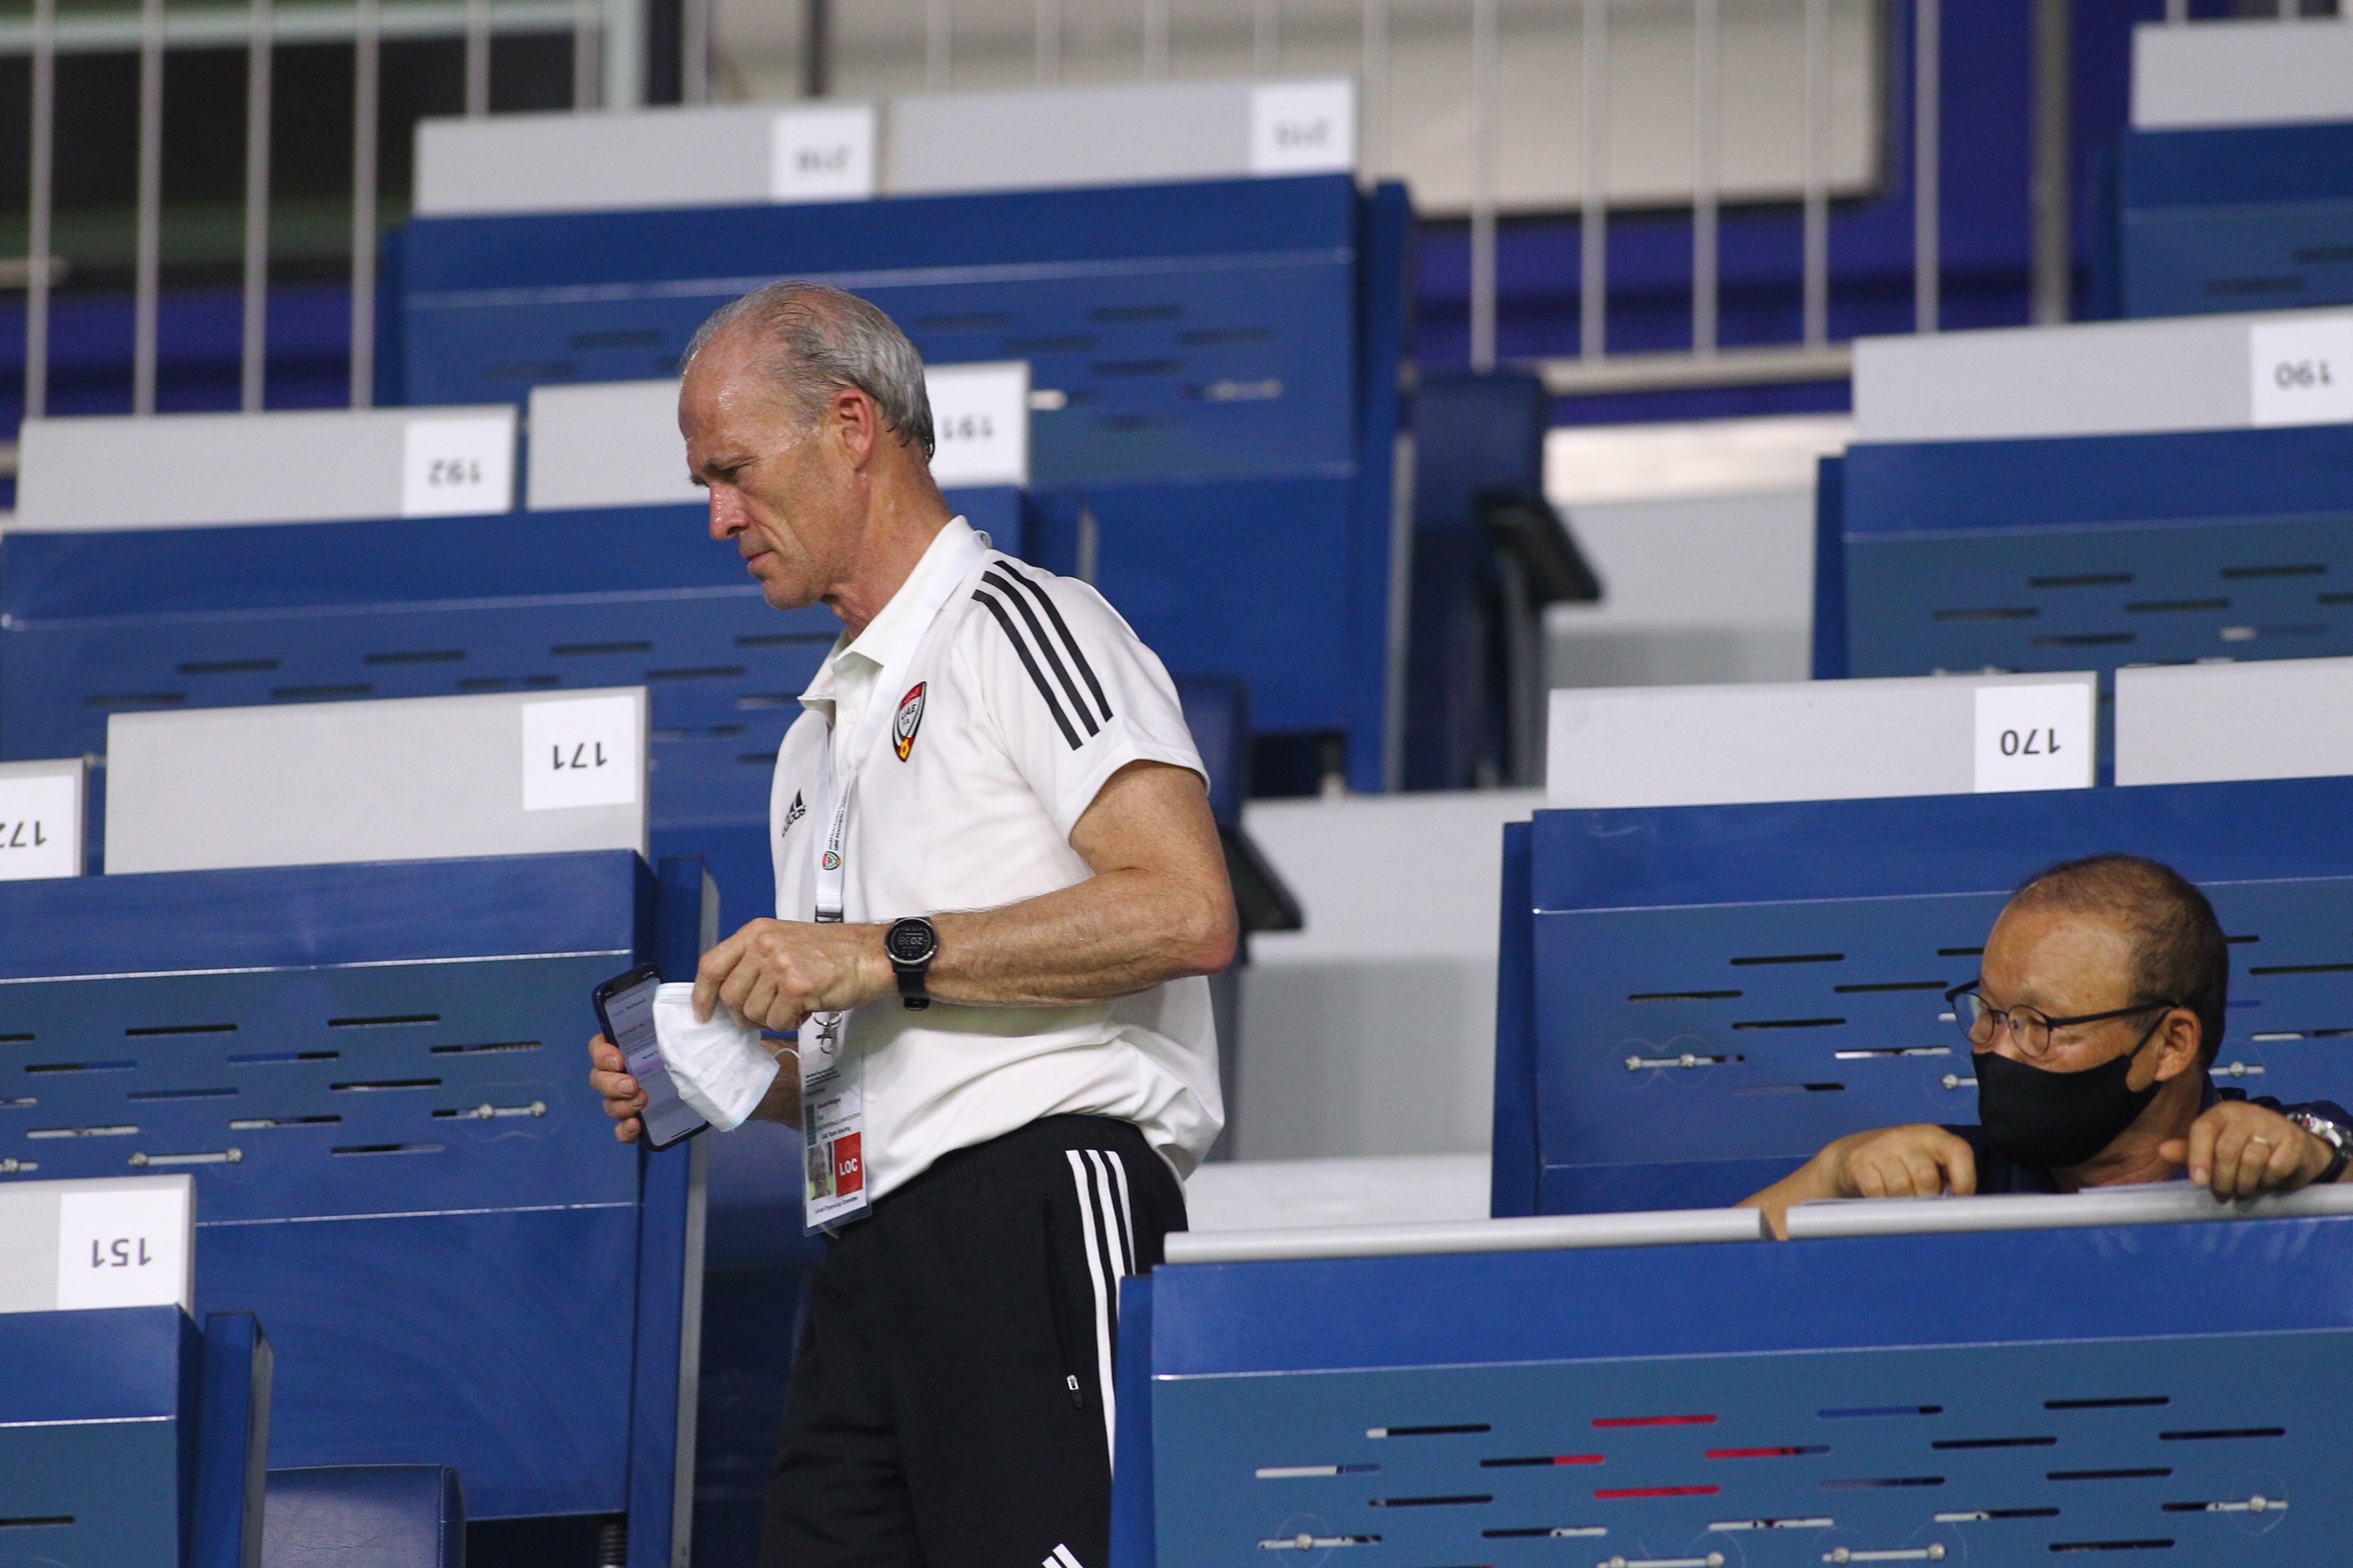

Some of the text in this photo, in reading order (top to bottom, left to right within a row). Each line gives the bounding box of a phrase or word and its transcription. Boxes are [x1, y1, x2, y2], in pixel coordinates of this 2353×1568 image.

[2274, 360, 2332, 389] 190
[942, 415, 994, 441] 191
[427, 458, 483, 487] 192
[552, 741, 608, 770] 171
[2000, 728, 2060, 756] 170
[839, 1158, 858, 1176] LOC
[91, 1237, 153, 1268] 151
